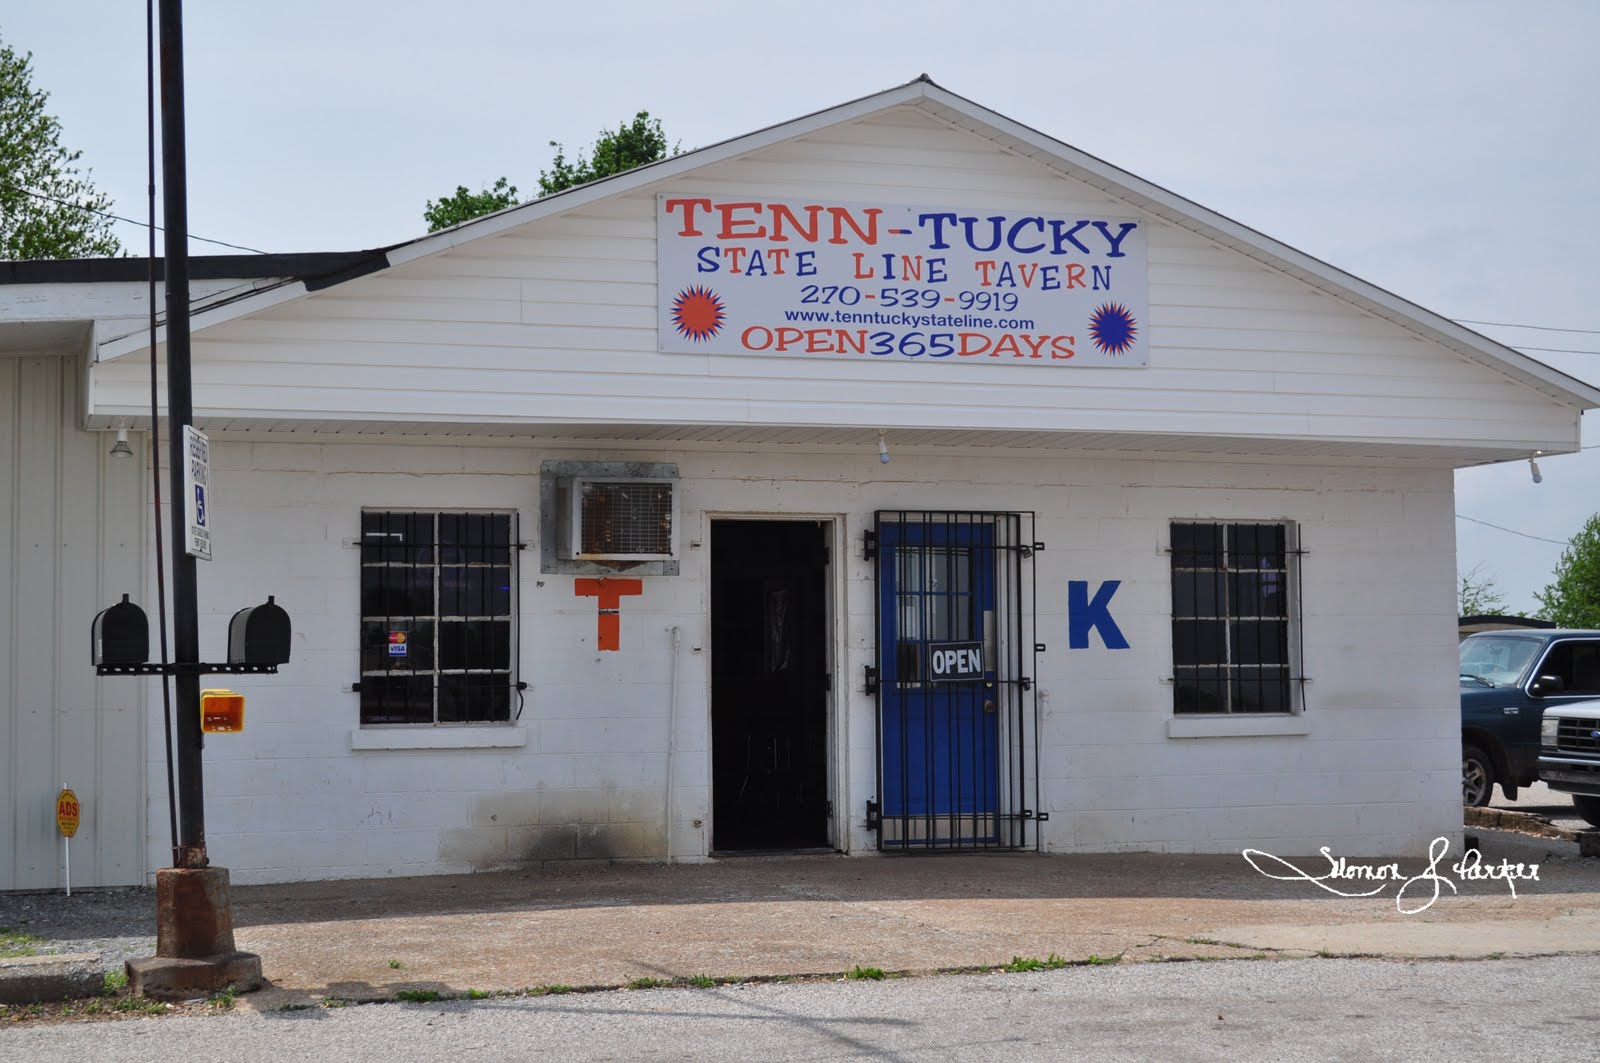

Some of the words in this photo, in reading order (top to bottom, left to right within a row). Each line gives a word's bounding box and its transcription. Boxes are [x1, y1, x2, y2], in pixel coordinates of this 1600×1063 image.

[697, 246, 817, 277] STATE
[853, 252, 948, 284] LINE
[974, 260, 1112, 291] TAVERN
[800, 284, 1020, 312] 270-539-9919
[785, 310, 1035, 330] www.tenntuckystateline.com
[575, 577, 643, 652] T
[1068, 580, 1131, 650] K
[932, 648, 981, 674] OPEN
[59, 800, 78, 817] ADS
